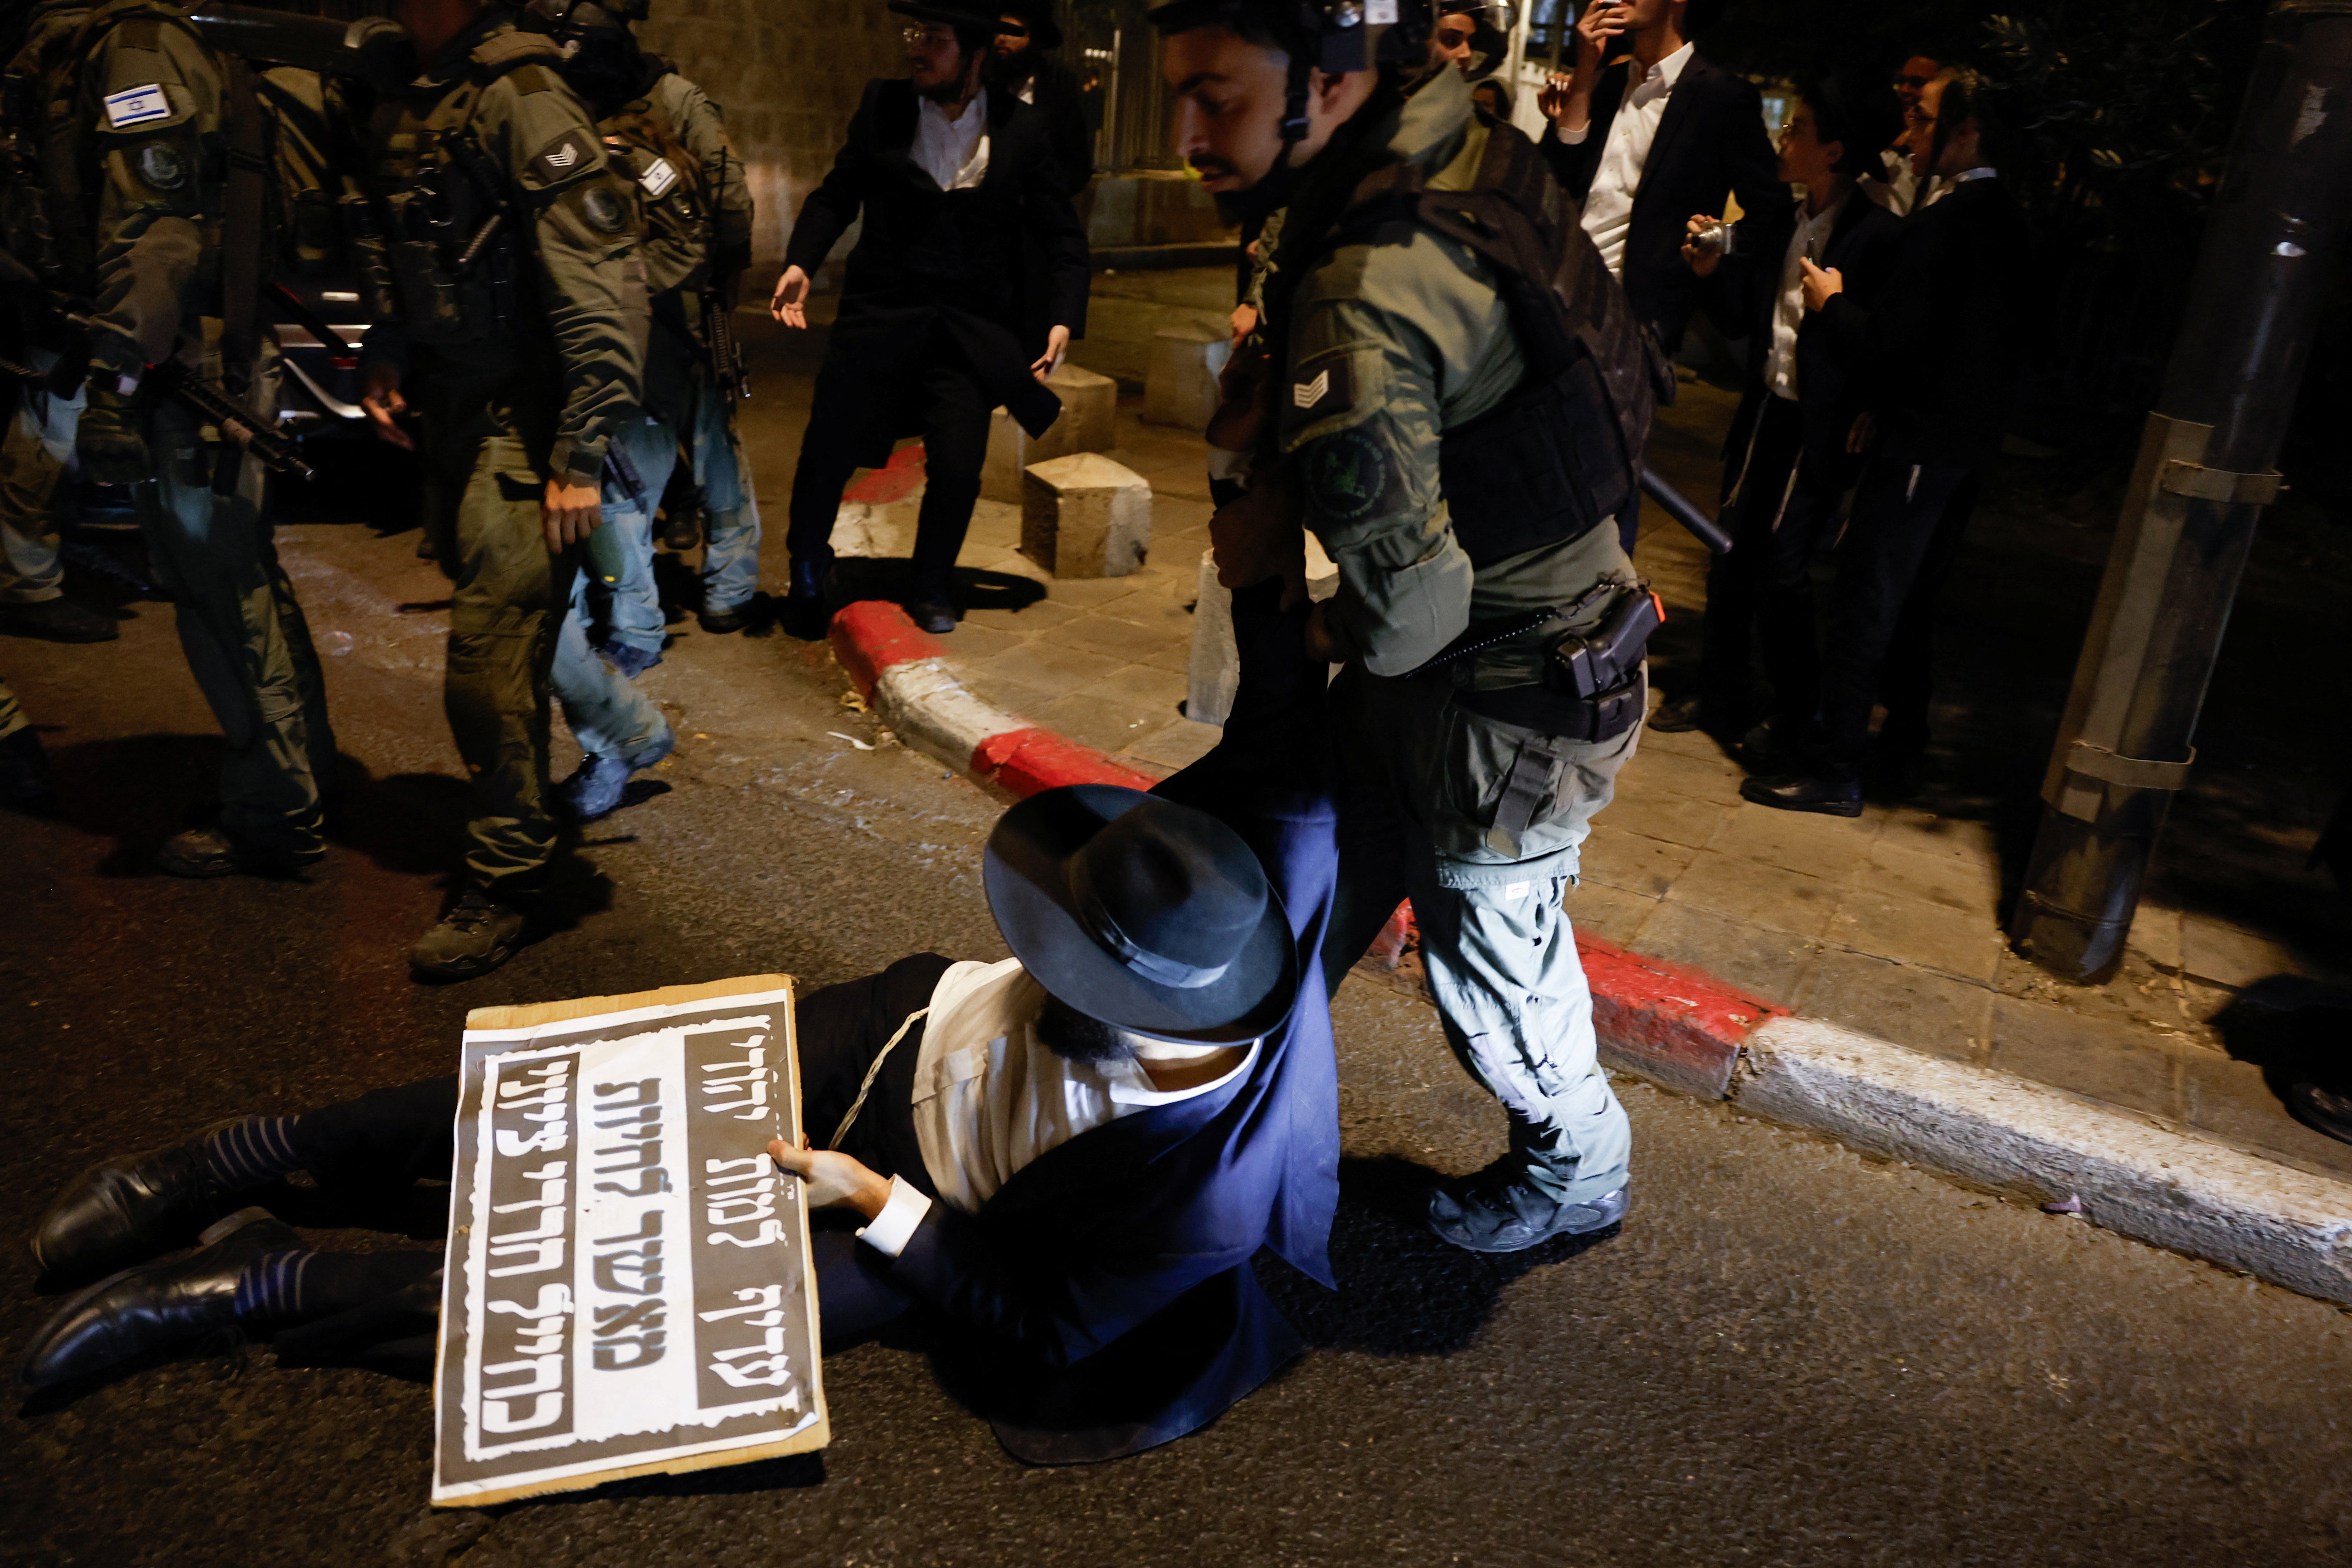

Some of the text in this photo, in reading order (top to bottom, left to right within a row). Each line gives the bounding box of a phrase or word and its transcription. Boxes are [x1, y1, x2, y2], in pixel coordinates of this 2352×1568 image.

[482, 1060, 574, 1433] כחייל חרדי ציוני
[592, 1078, 672, 1371] מאשר לחיות
[698, 1035, 791, 1387] עדיף למות יהודי
